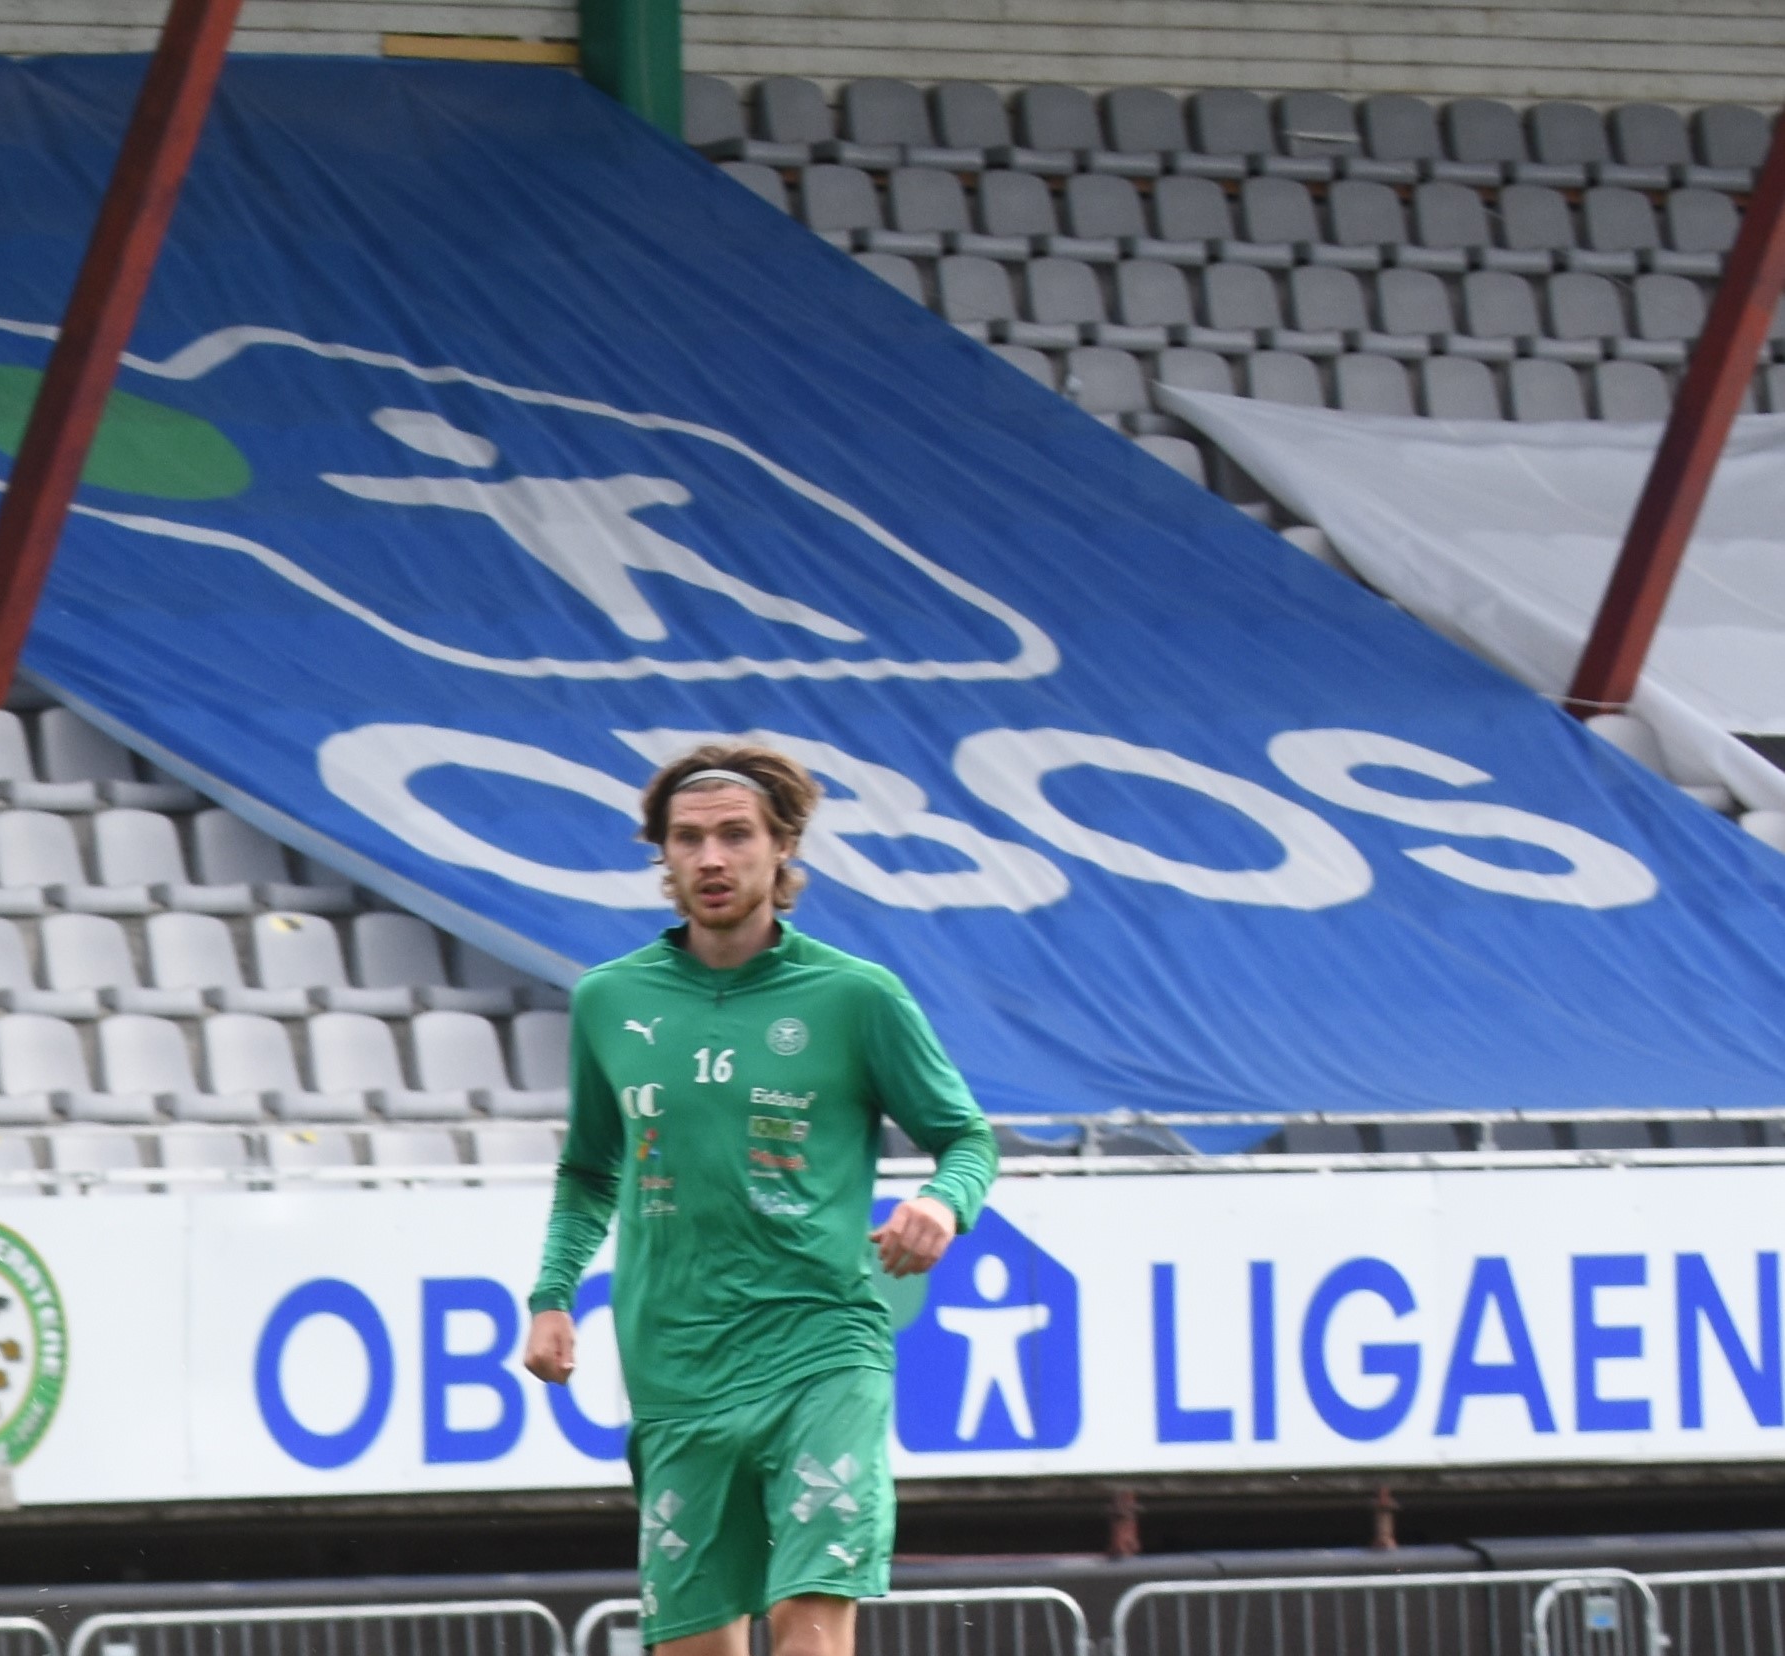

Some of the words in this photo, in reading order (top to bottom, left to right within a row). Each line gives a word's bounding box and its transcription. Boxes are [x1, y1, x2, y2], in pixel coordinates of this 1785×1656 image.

[317, 722, 1658, 912] OBOS
[693, 1048, 735, 1083] 16
[1151, 1250, 1785, 1443] LIGAEN
